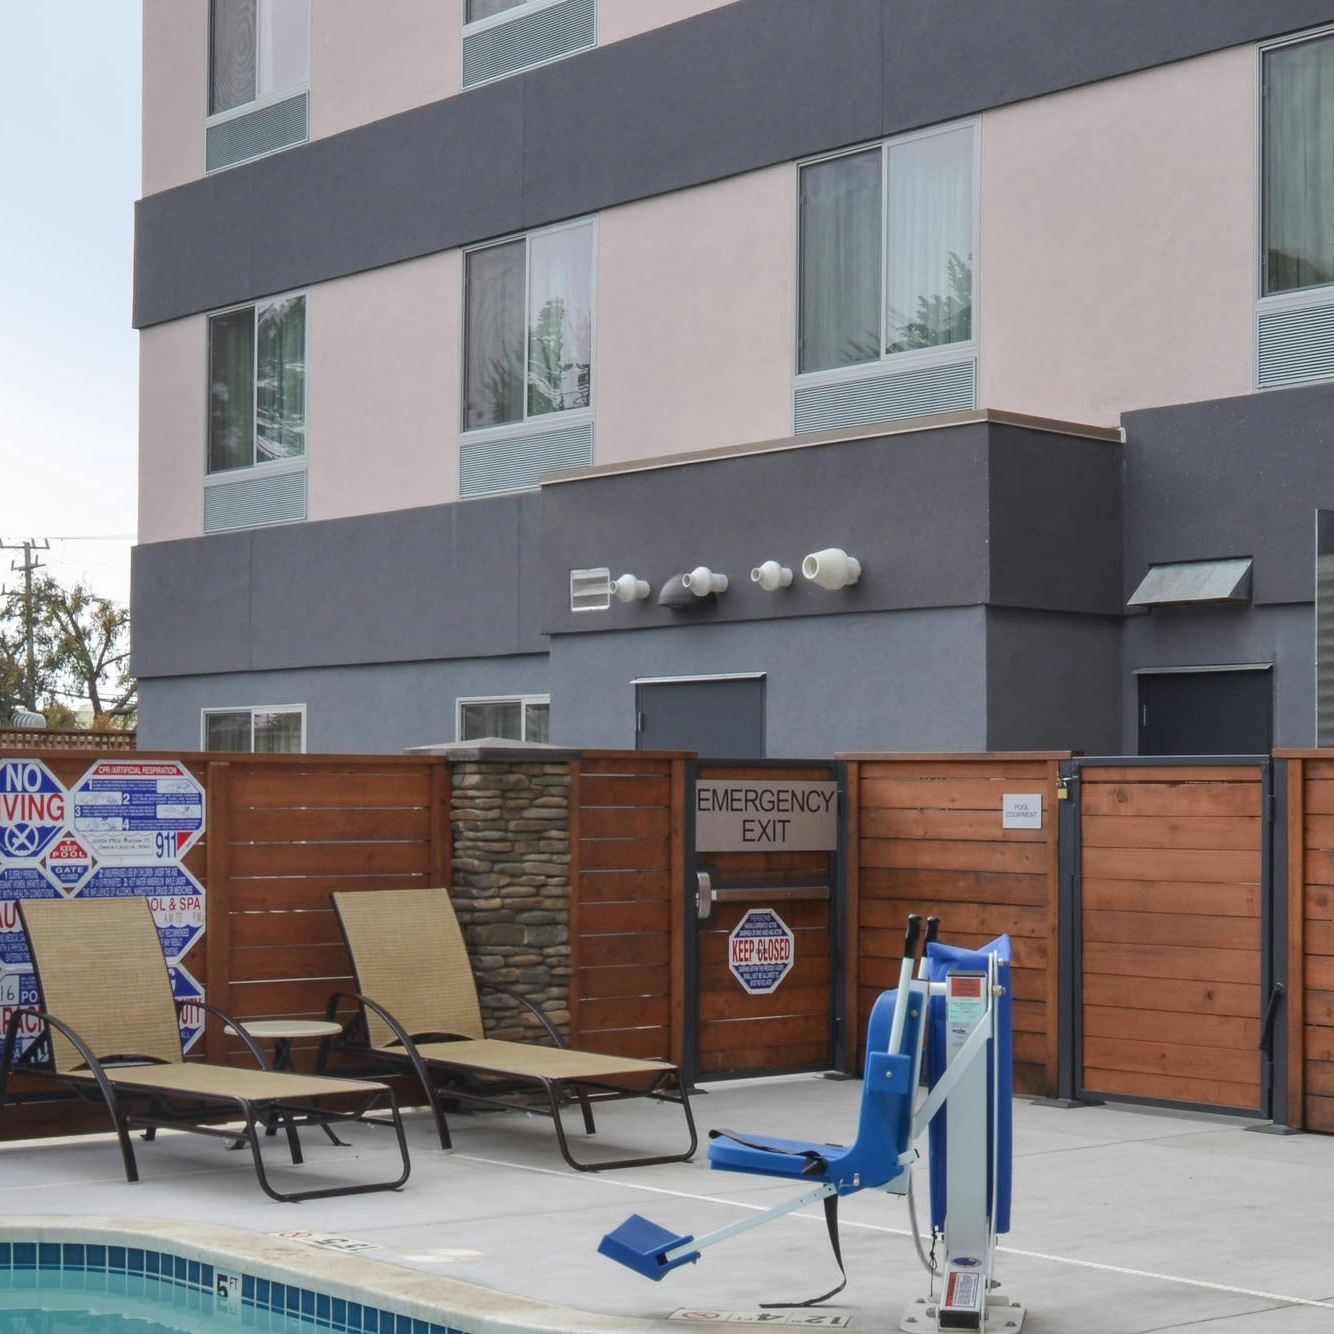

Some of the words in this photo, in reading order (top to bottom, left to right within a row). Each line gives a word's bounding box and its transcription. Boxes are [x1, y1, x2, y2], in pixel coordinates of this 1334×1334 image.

[5, 763, 42, 793] NO
[697, 788, 835, 813] EMERGENCY
[742, 818, 791, 843] EXIT
[155, 831, 177, 858] 911
[168, 897, 176, 911] &
[179, 896, 201, 910] SPA
[732, 939, 755, 962] KEEP
[757, 938, 790, 961] CLOSED
[0, 985, 15, 1001] 16
[216, 1274, 229, 1297] 5
[229, 1275, 239, 1291] FT
